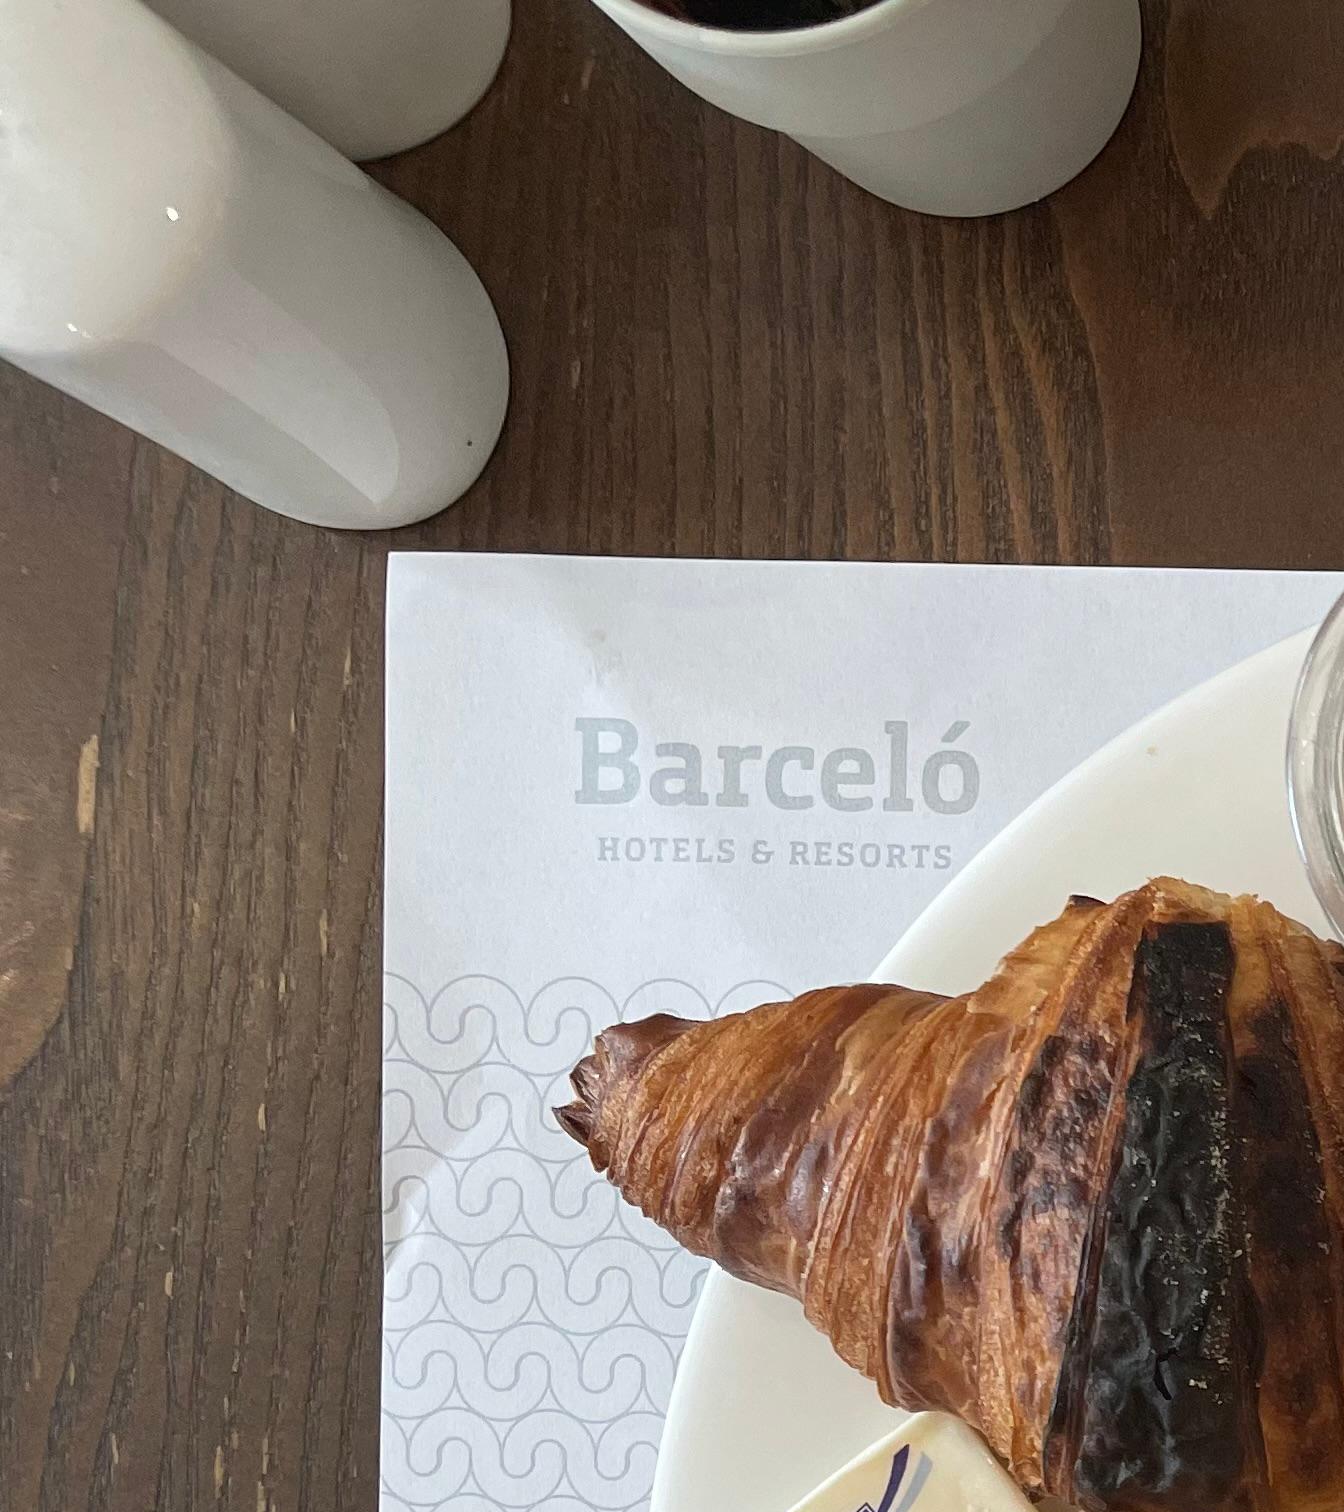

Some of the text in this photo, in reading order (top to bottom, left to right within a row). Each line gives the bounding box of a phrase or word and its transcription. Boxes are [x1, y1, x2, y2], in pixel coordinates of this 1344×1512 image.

[575, 718, 980, 814] Barceló
[597, 837, 950, 869] HOTELS & RESORTS
